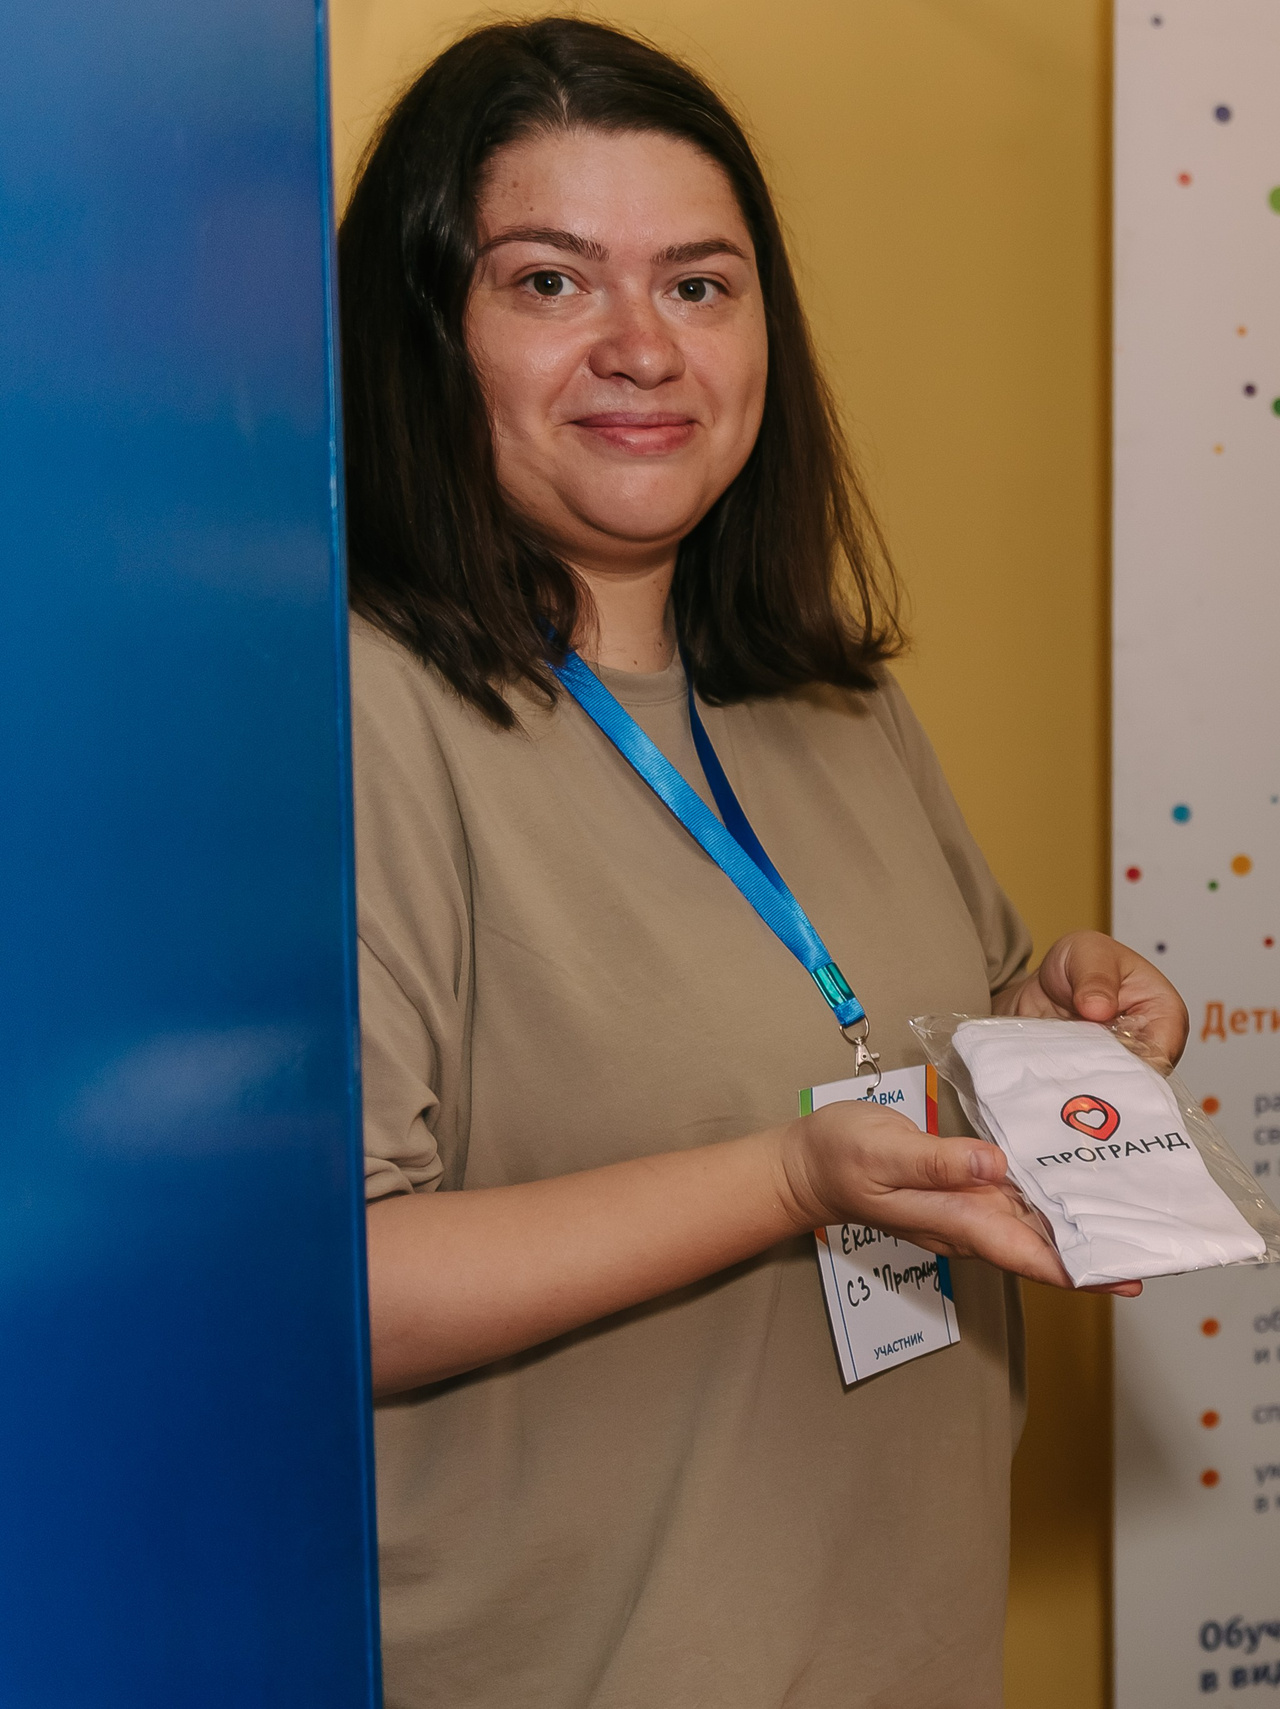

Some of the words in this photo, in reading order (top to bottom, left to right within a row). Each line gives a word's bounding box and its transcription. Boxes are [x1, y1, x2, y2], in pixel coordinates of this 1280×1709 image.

[1036, 1132, 1191, 1167] ПРОГРАНД
[873, 1331, 925, 1360] УЧАСТНИК
[1199, 1670, 1219, 1693] в
